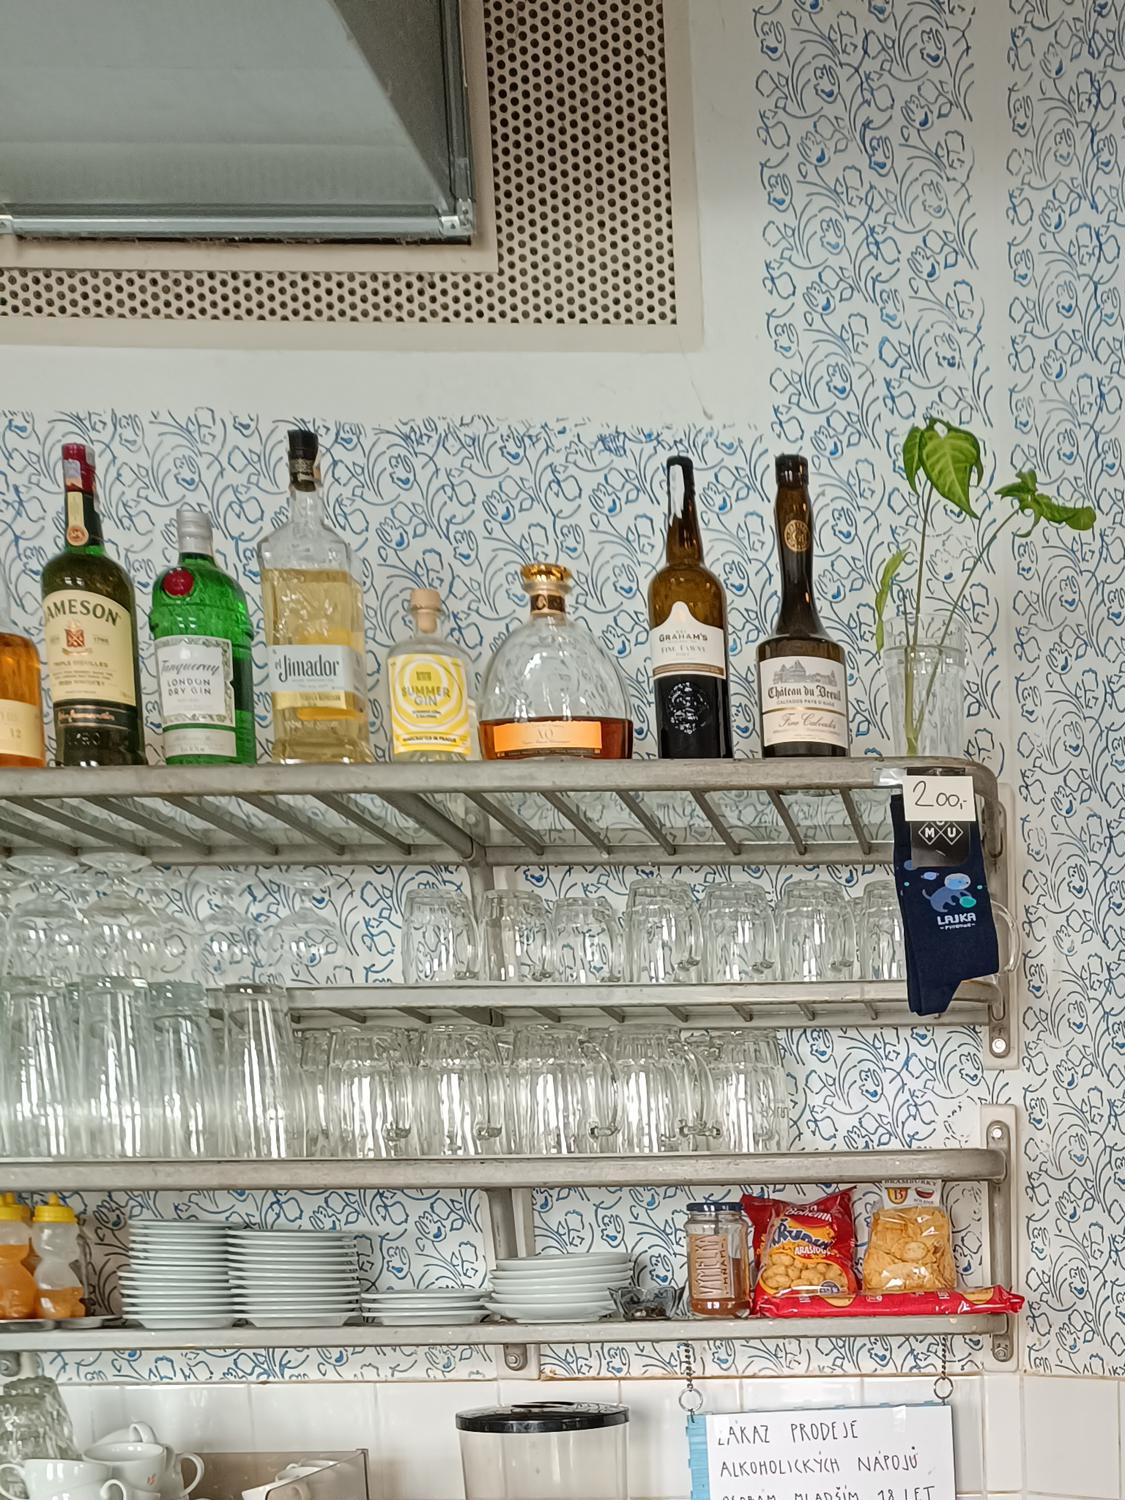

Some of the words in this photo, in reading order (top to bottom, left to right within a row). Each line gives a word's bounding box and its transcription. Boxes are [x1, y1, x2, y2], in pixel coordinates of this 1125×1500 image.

[45, 598, 120, 627] AMESON
[162, 659, 220, 676] Tanqueray
[279, 654, 340, 683] Jimador
[167, 678, 211, 688] LONDON
[168, 687, 186, 697] DRY
[191, 687, 212, 696] GIN
[401, 686, 451, 698] SUMMER
[414, 696, 438, 706] GIN
[937, 913, 977, 926] LAJKA
[791, 1420, 859, 1443] PRODEJE
[720, 1451, 840, 1478] ALKOHOLICKÝCH
[858, 1446, 919, 1472] NÁPOJŮ
